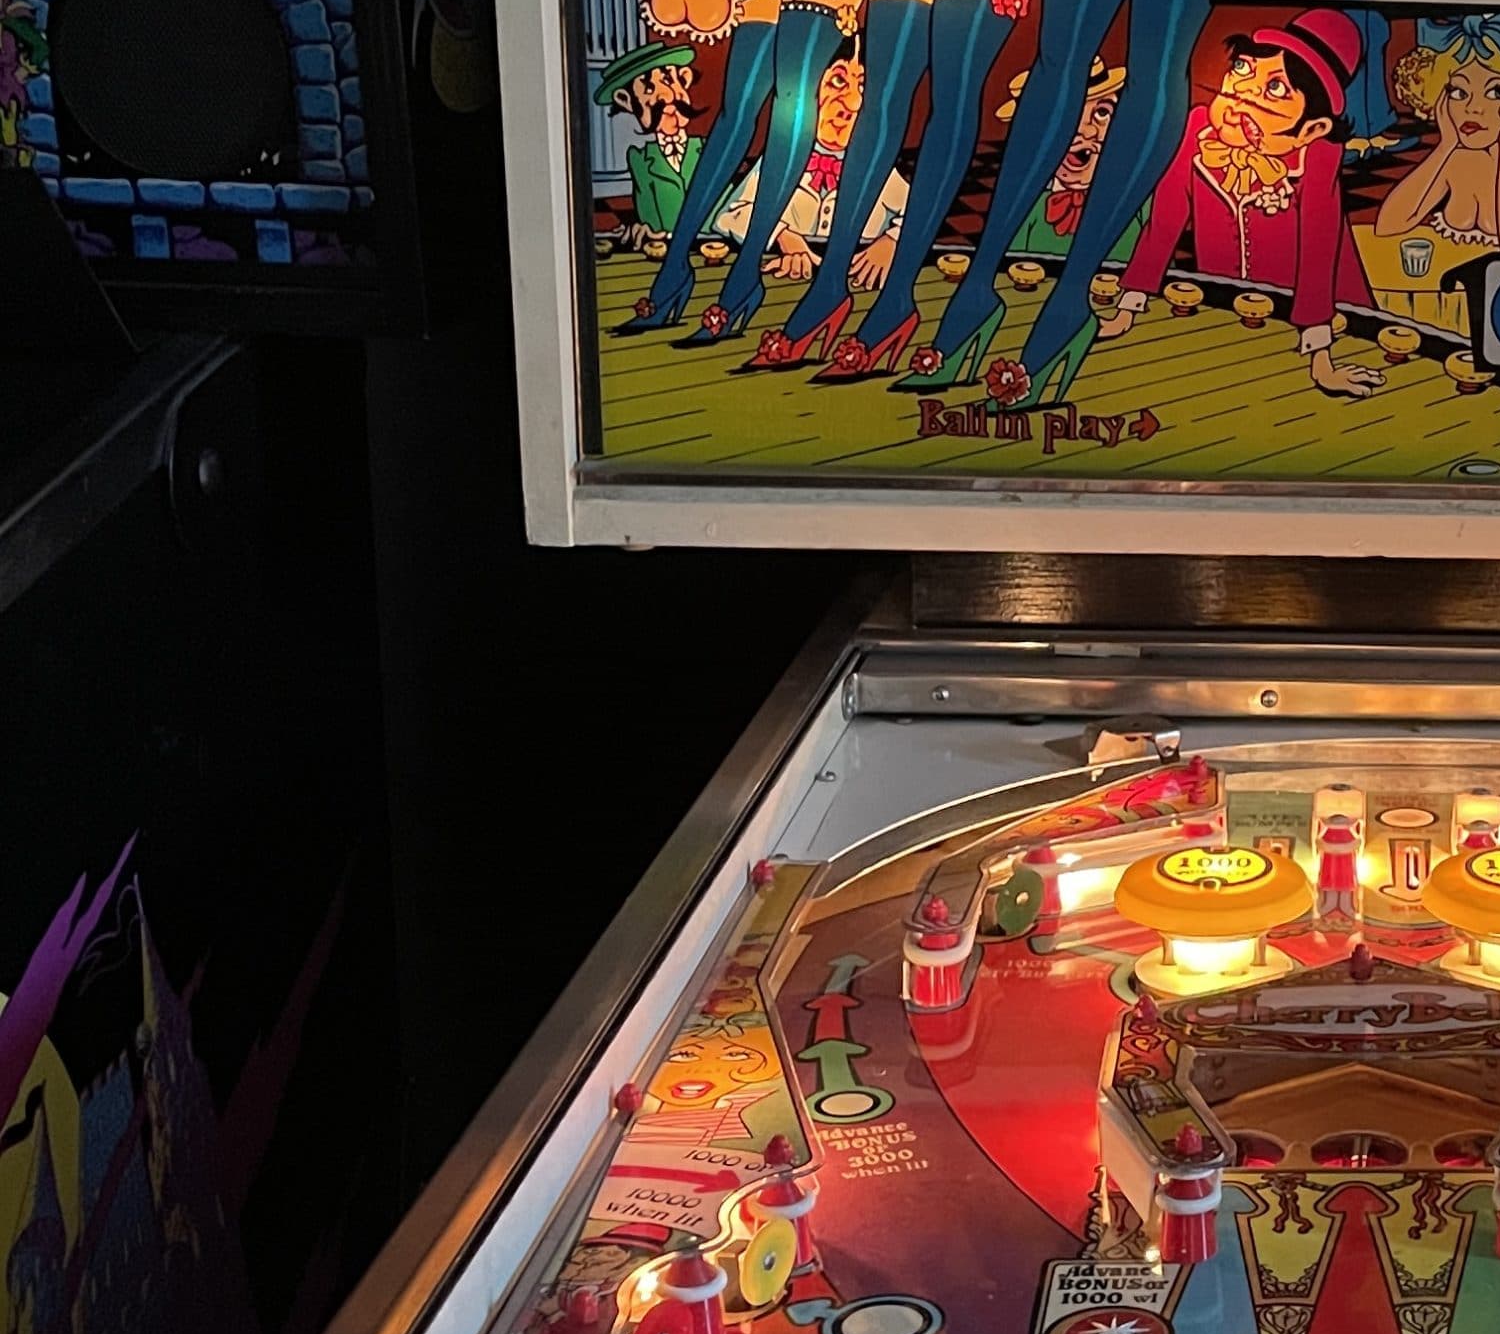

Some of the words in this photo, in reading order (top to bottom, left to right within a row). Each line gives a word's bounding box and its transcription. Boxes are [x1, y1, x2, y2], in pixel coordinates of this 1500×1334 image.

[917, 398, 988, 438] Ball
[994, 408, 1033, 441] in
[1041, 402, 1126, 455] play
[684, 1148, 743, 1169] 1000
[626, 1186, 702, 1209] 10000
[605, 1200, 670, 1223] when
[672, 1208, 704, 1227] lit
[1059, 1264, 1162, 1278] Advanc
[1057, 1276, 1142, 1291] BONUS
[1061, 1292, 1124, 1305] 1000
